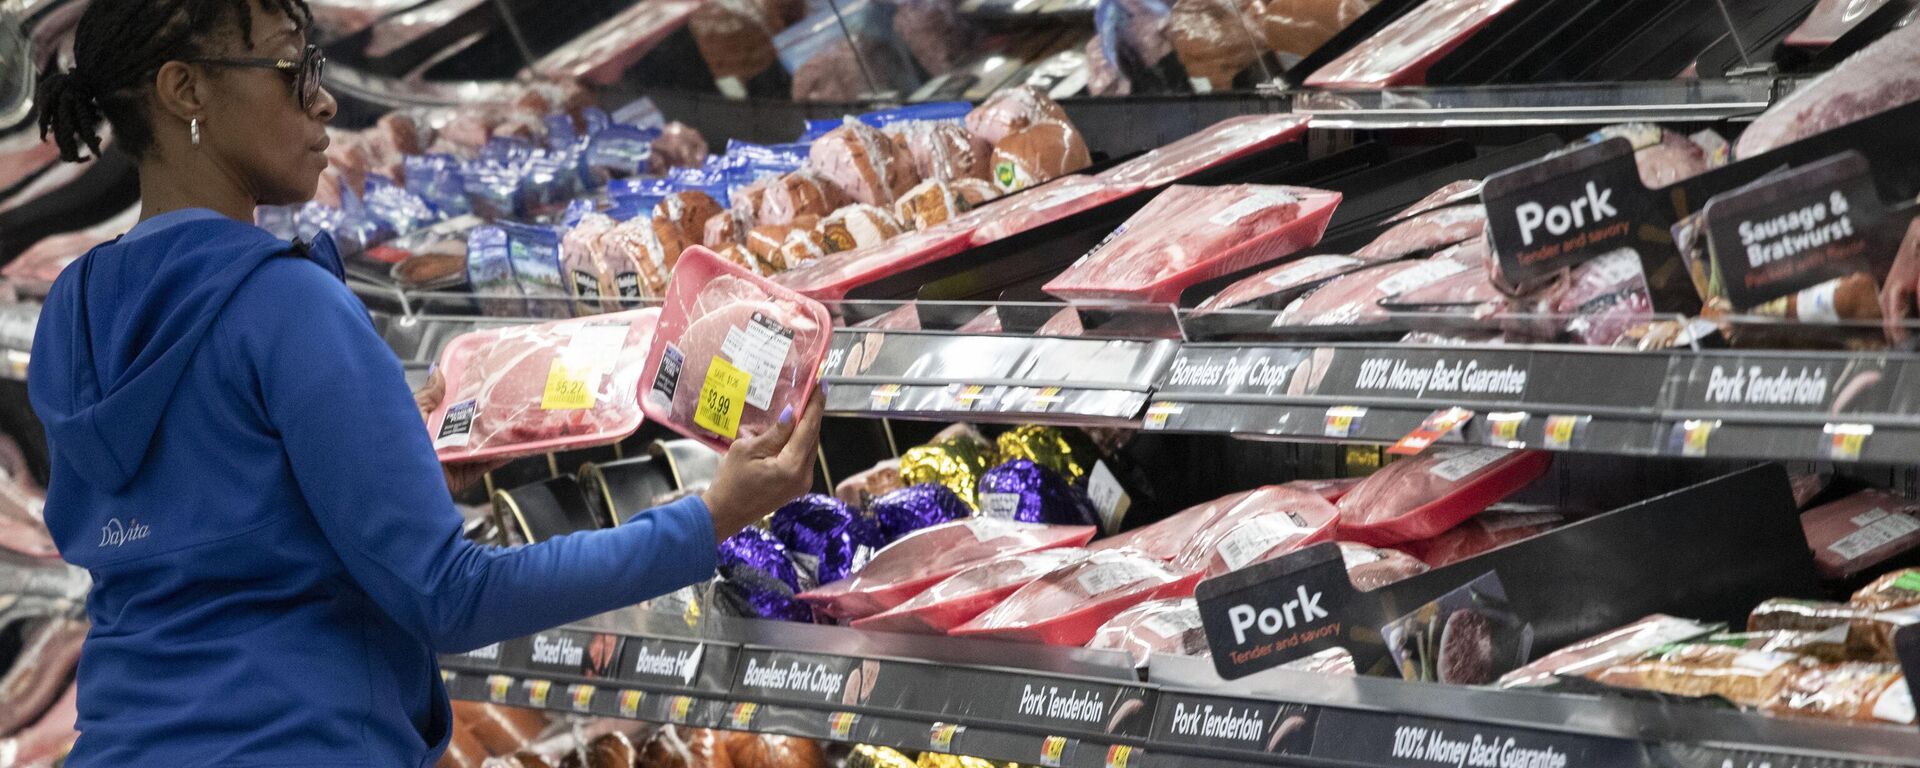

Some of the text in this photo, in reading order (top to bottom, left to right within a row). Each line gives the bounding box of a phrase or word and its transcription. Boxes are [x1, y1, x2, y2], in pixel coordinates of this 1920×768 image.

[1515, 181, 1618, 246] Pork
[1738, 190, 1849, 245] Sausage &
[1746, 215, 1853, 268] Bratwurst
[556, 380, 585, 394] $5.27
[1170, 356, 1289, 394] Boneless Pork Chops
[1355, 358, 1527, 399] 100% Money Back Guarantee
[1705, 365, 1829, 404] Pork Tenderloin
[707, 388, 731, 415] $3.99
[99, 517, 149, 548] DaVita
[1228, 584, 1329, 645] Pork
[532, 634, 583, 666] Sliced Ham
[636, 646, 677, 676] Boneless
[1230, 622, 1342, 665] Tender and savory
[743, 658, 844, 700] Boneless Pork Chops
[1018, 684, 1104, 723] Pork Tenderloin
[1171, 702, 1264, 742] Pork Tenderloin
[1392, 726, 1567, 768] 100% Money Back Guarantee
